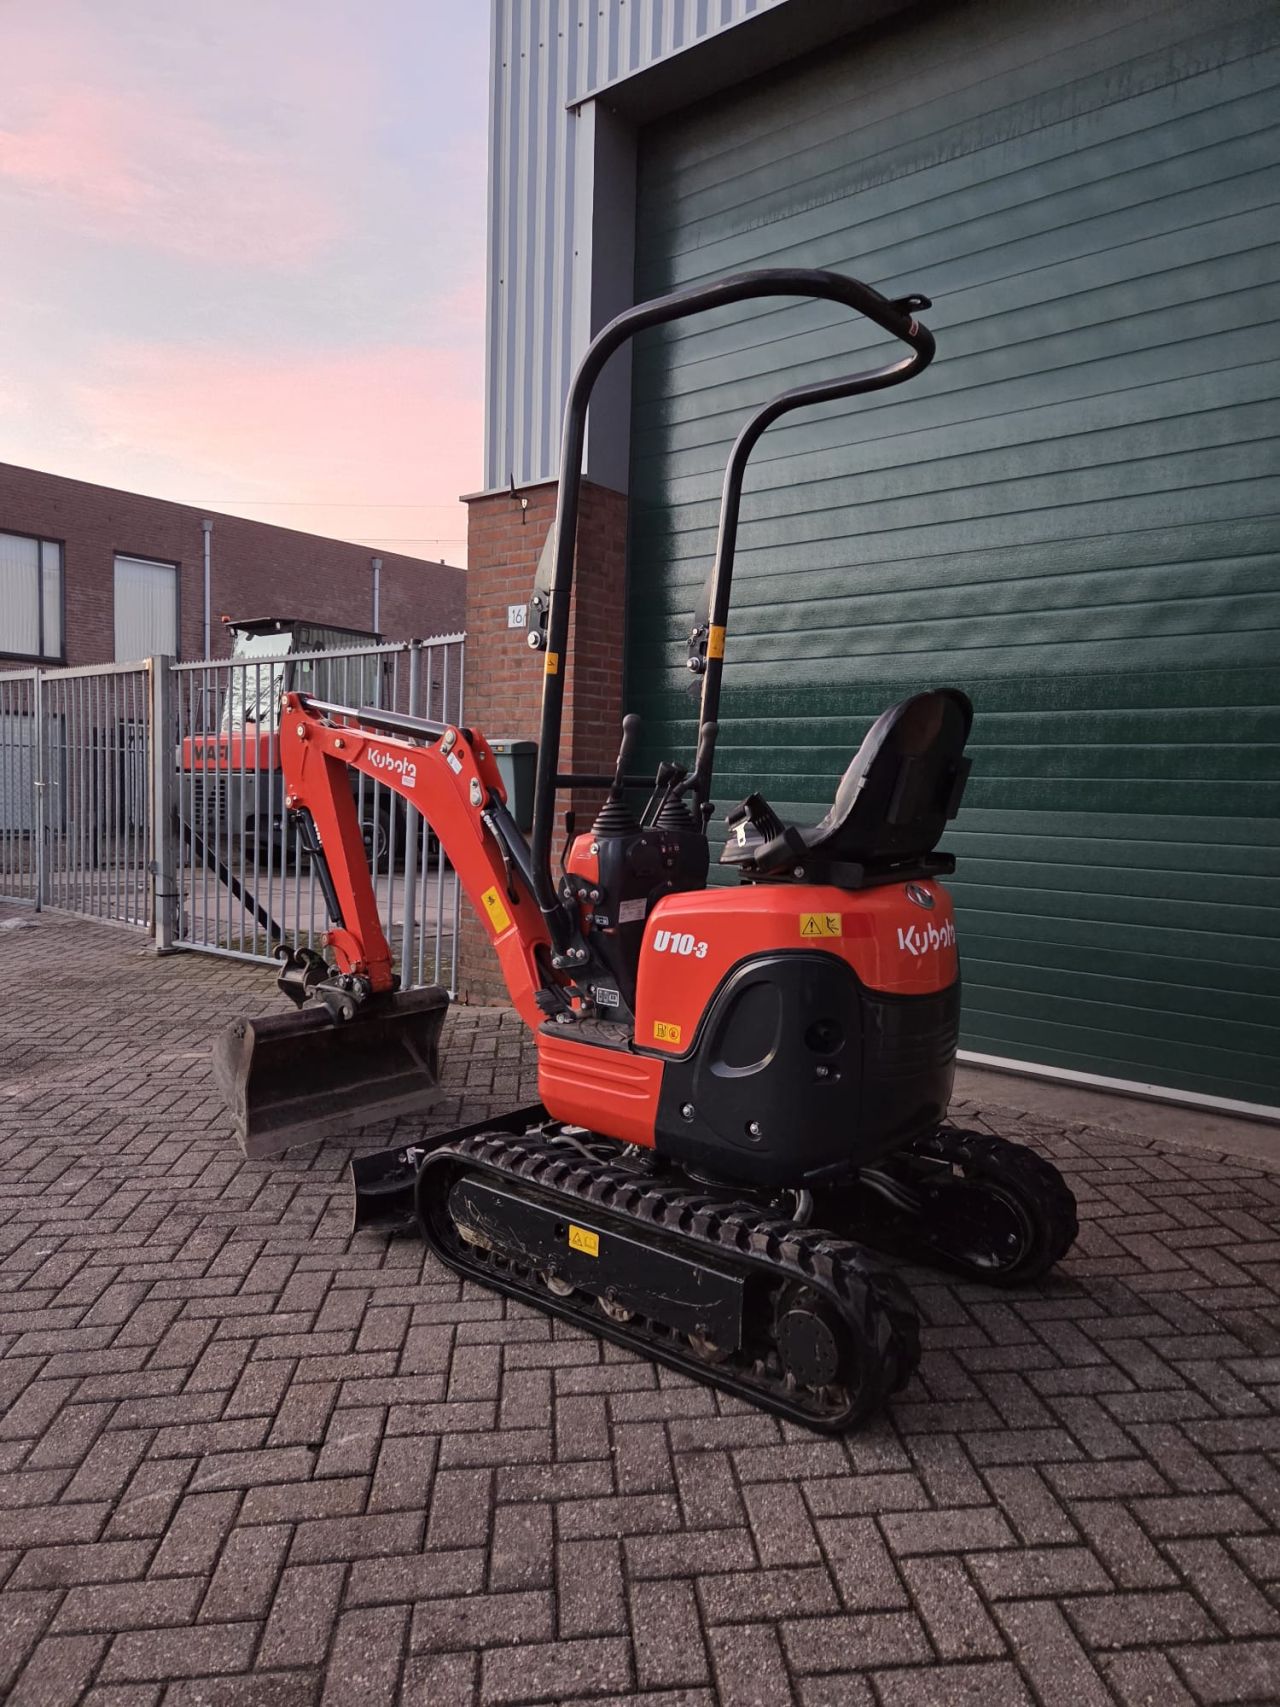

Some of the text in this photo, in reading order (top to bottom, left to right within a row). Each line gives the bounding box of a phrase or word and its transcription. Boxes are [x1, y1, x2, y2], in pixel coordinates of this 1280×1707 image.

[512, 608, 523, 624] 16
[367, 747, 417, 778] Kubota
[653, 929, 709, 959] U10-3
